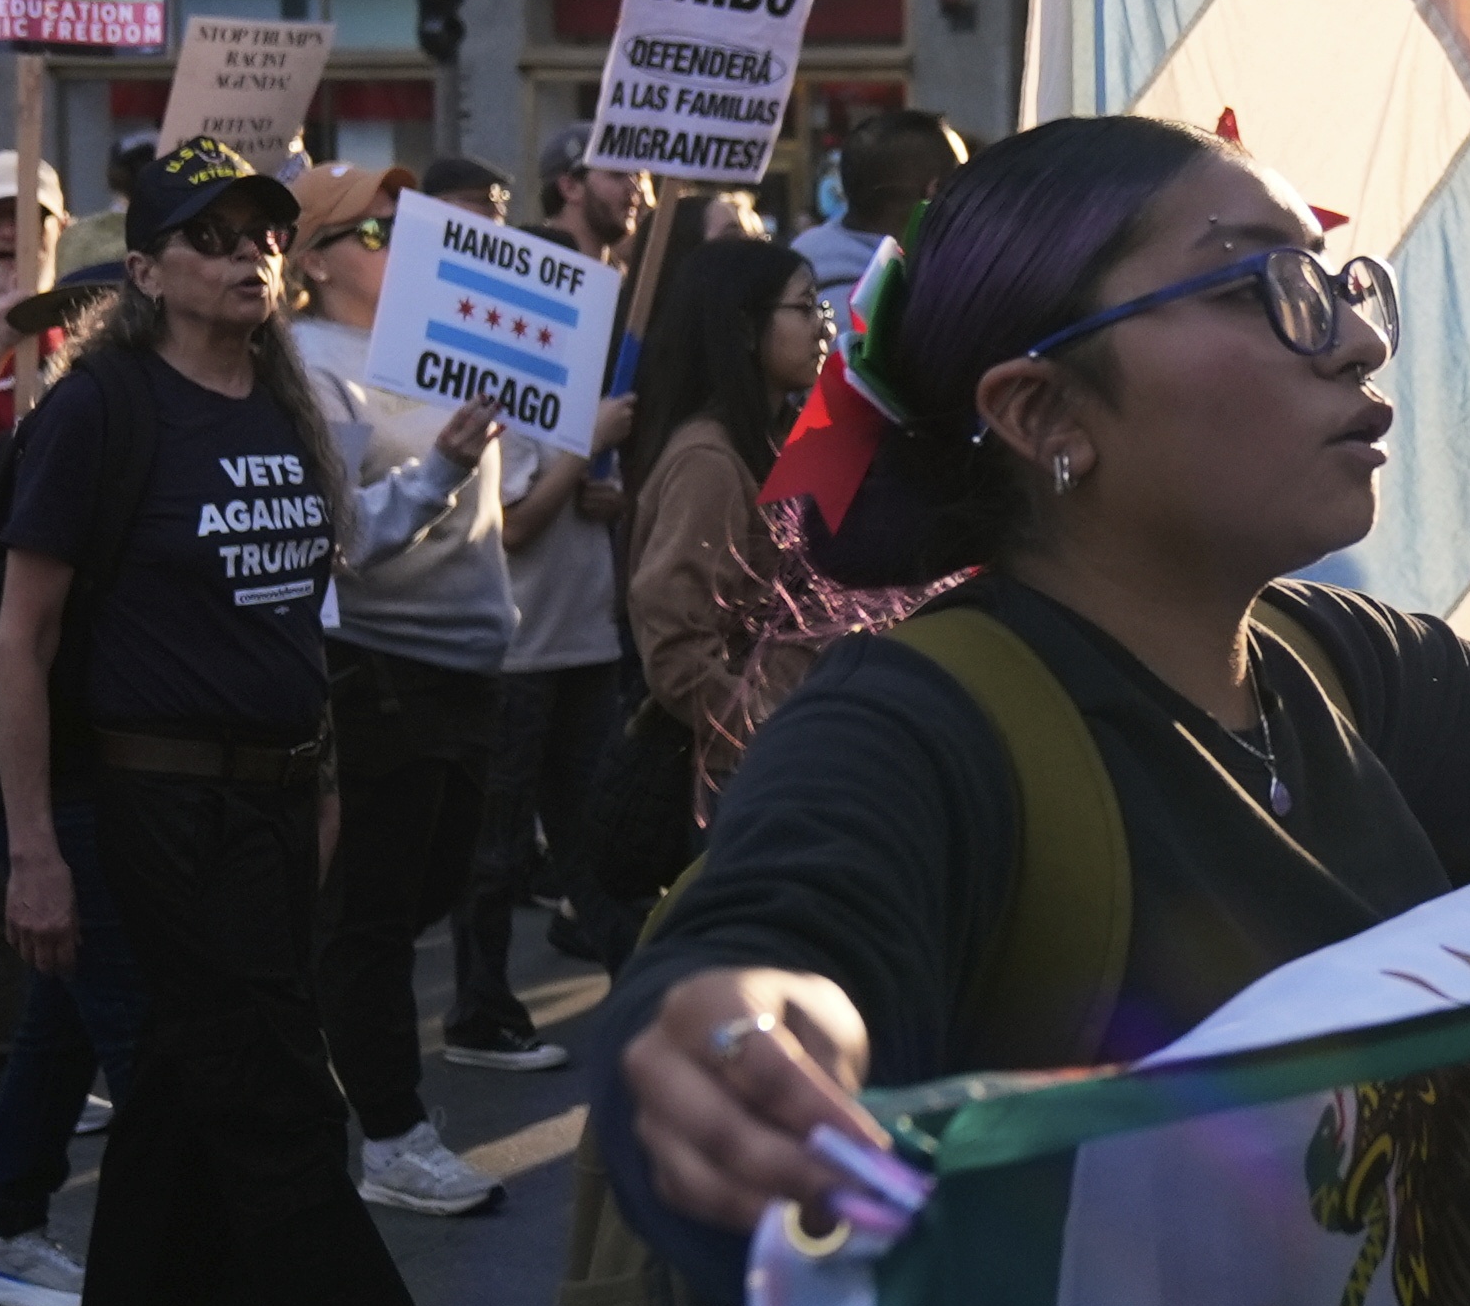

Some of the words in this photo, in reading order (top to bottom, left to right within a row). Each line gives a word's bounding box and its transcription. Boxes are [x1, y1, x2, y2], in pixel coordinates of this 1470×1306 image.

[41, 17, 163, 43] FREEDOM
[197, 26, 249, 43] STOP
[629, 39, 772, 84] DEFENDERÁ
[610, 81, 624, 108] A
[631, 84, 669, 112] LAS
[674, 91, 780, 126] FAMILIAS
[596, 123, 769, 173] MIGRANTES!
[442, 219, 533, 277] HANDS
[539, 255, 586, 296] OFF
[414, 349, 561, 433] CHICAGO
[218, 453, 305, 488] VETS
[197, 494, 330, 538] AGAINST
[218, 536, 331, 579] TRUMP
